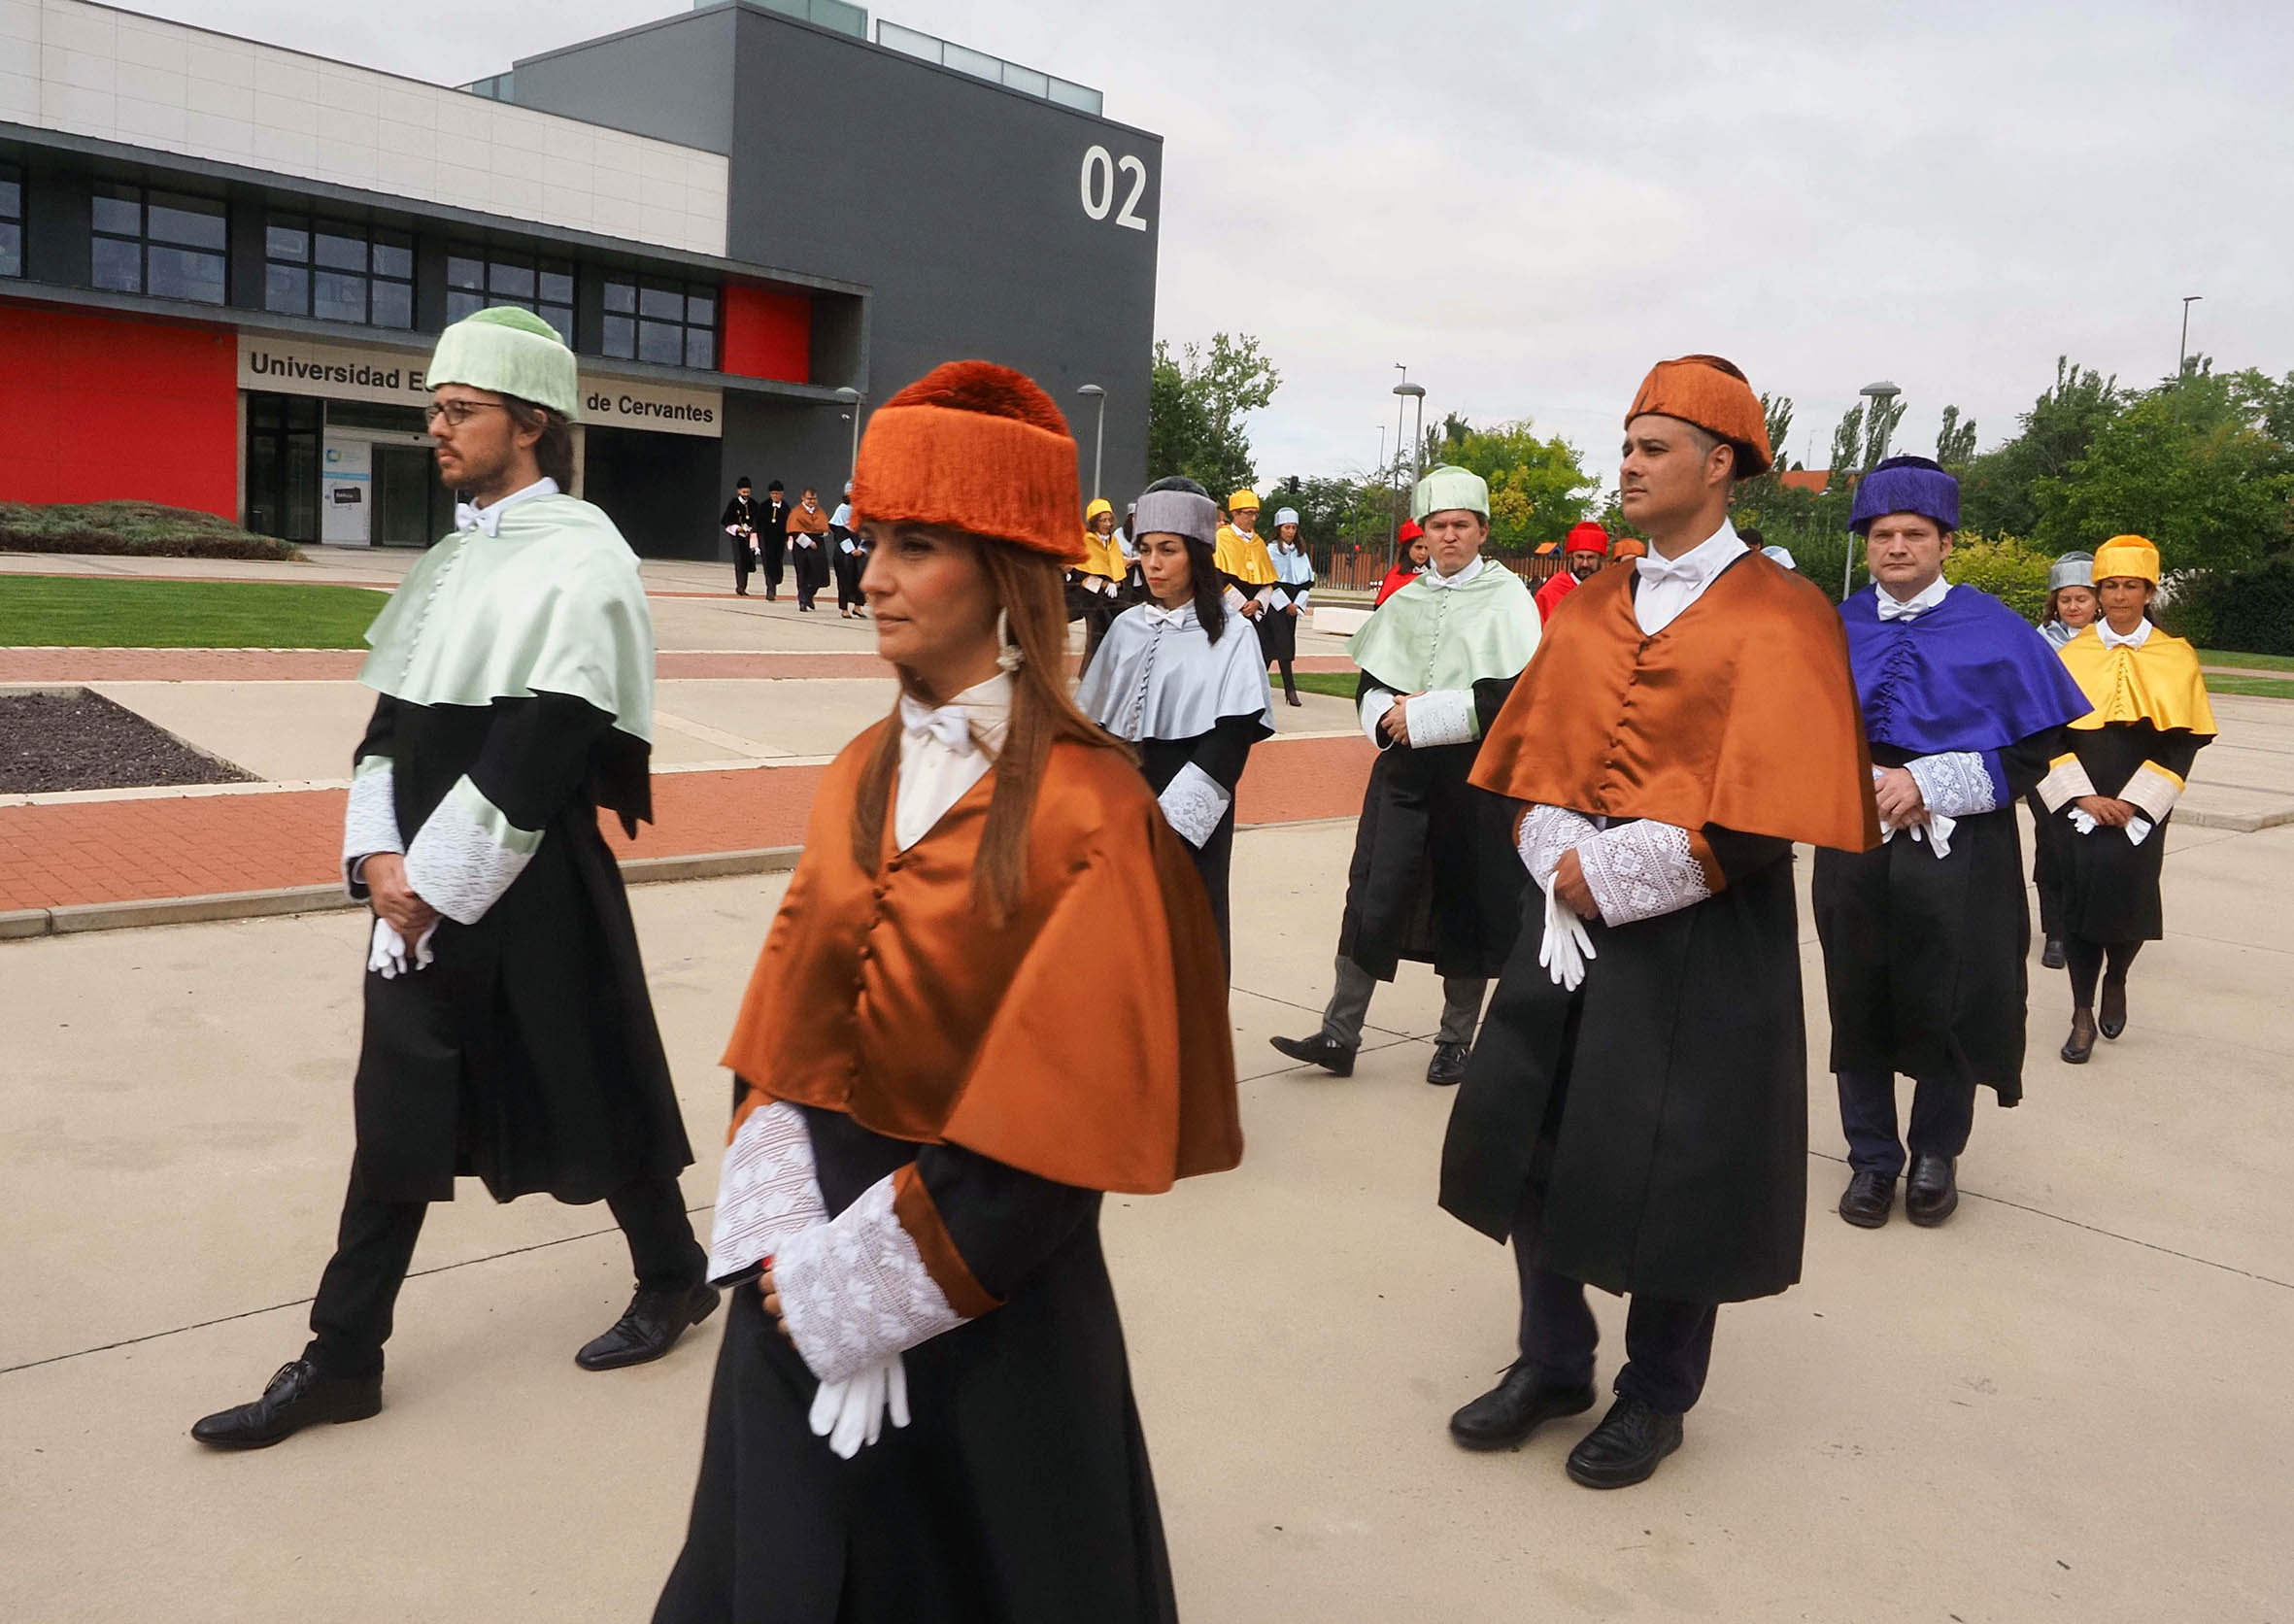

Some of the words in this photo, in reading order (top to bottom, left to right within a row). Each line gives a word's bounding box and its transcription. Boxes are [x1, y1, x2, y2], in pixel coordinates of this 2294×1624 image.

[1081, 145, 1147, 232] 02
[251, 352, 400, 389] Universidad
[409, 371, 436, 392] E
[587, 392, 612, 412] de
[619, 395, 714, 423] Cervantes
